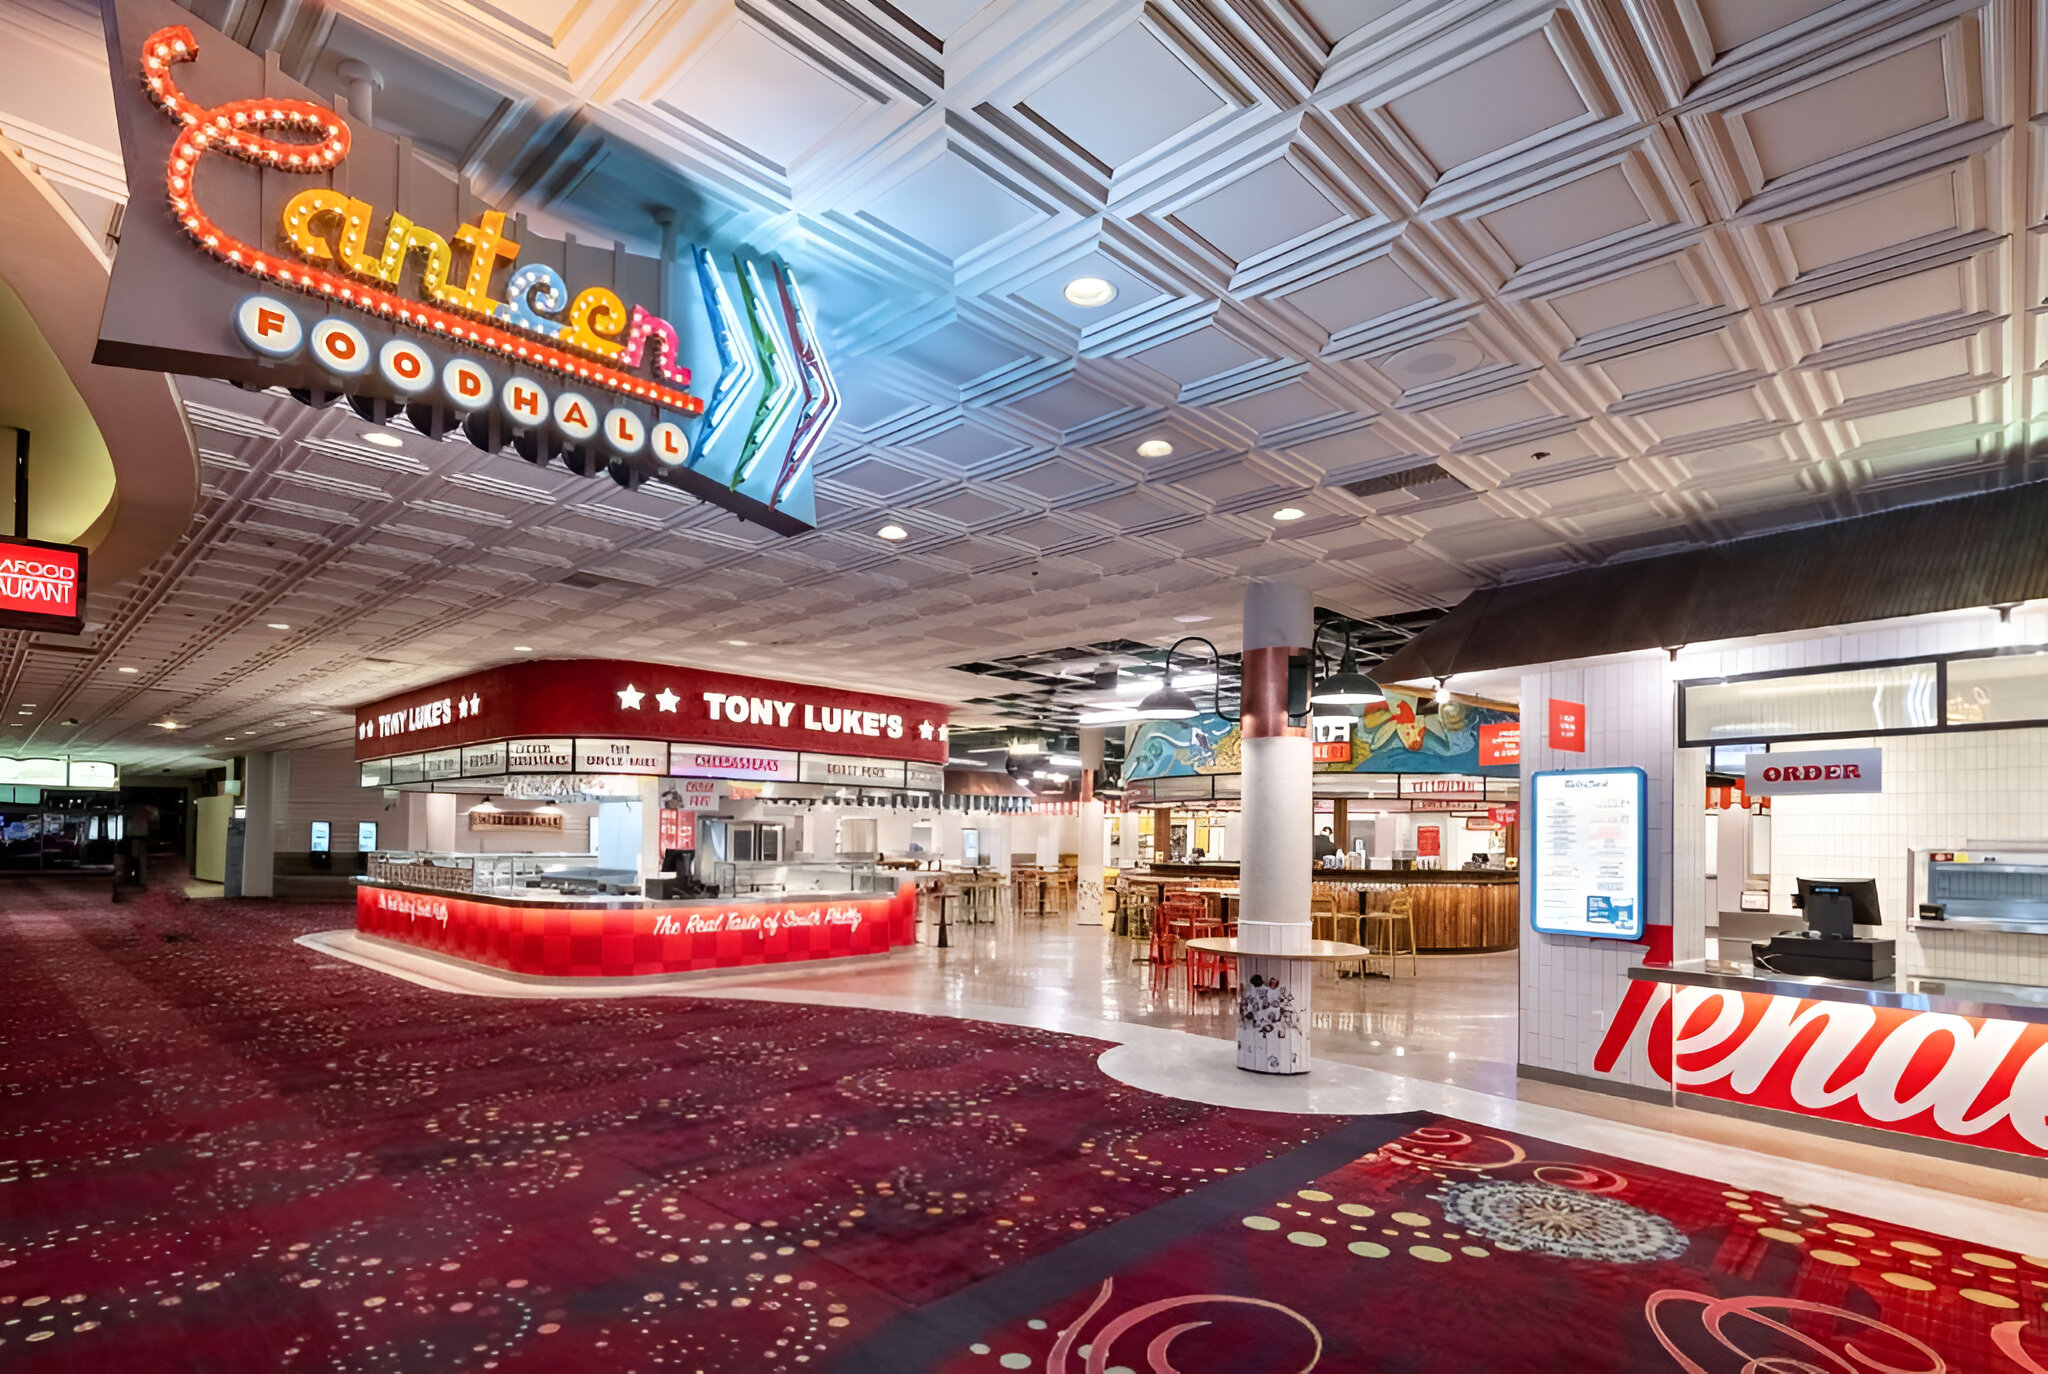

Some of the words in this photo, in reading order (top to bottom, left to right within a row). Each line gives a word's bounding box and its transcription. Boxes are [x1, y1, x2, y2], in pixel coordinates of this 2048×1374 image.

[141, 25, 704, 416] Canteen
[703, 692, 796, 728] TONY
[804, 704, 904, 739] LUKE'S
[1762, 764, 1861, 783] ORDER
[653, 914, 681, 936] The
[685, 913, 724, 934] Real
